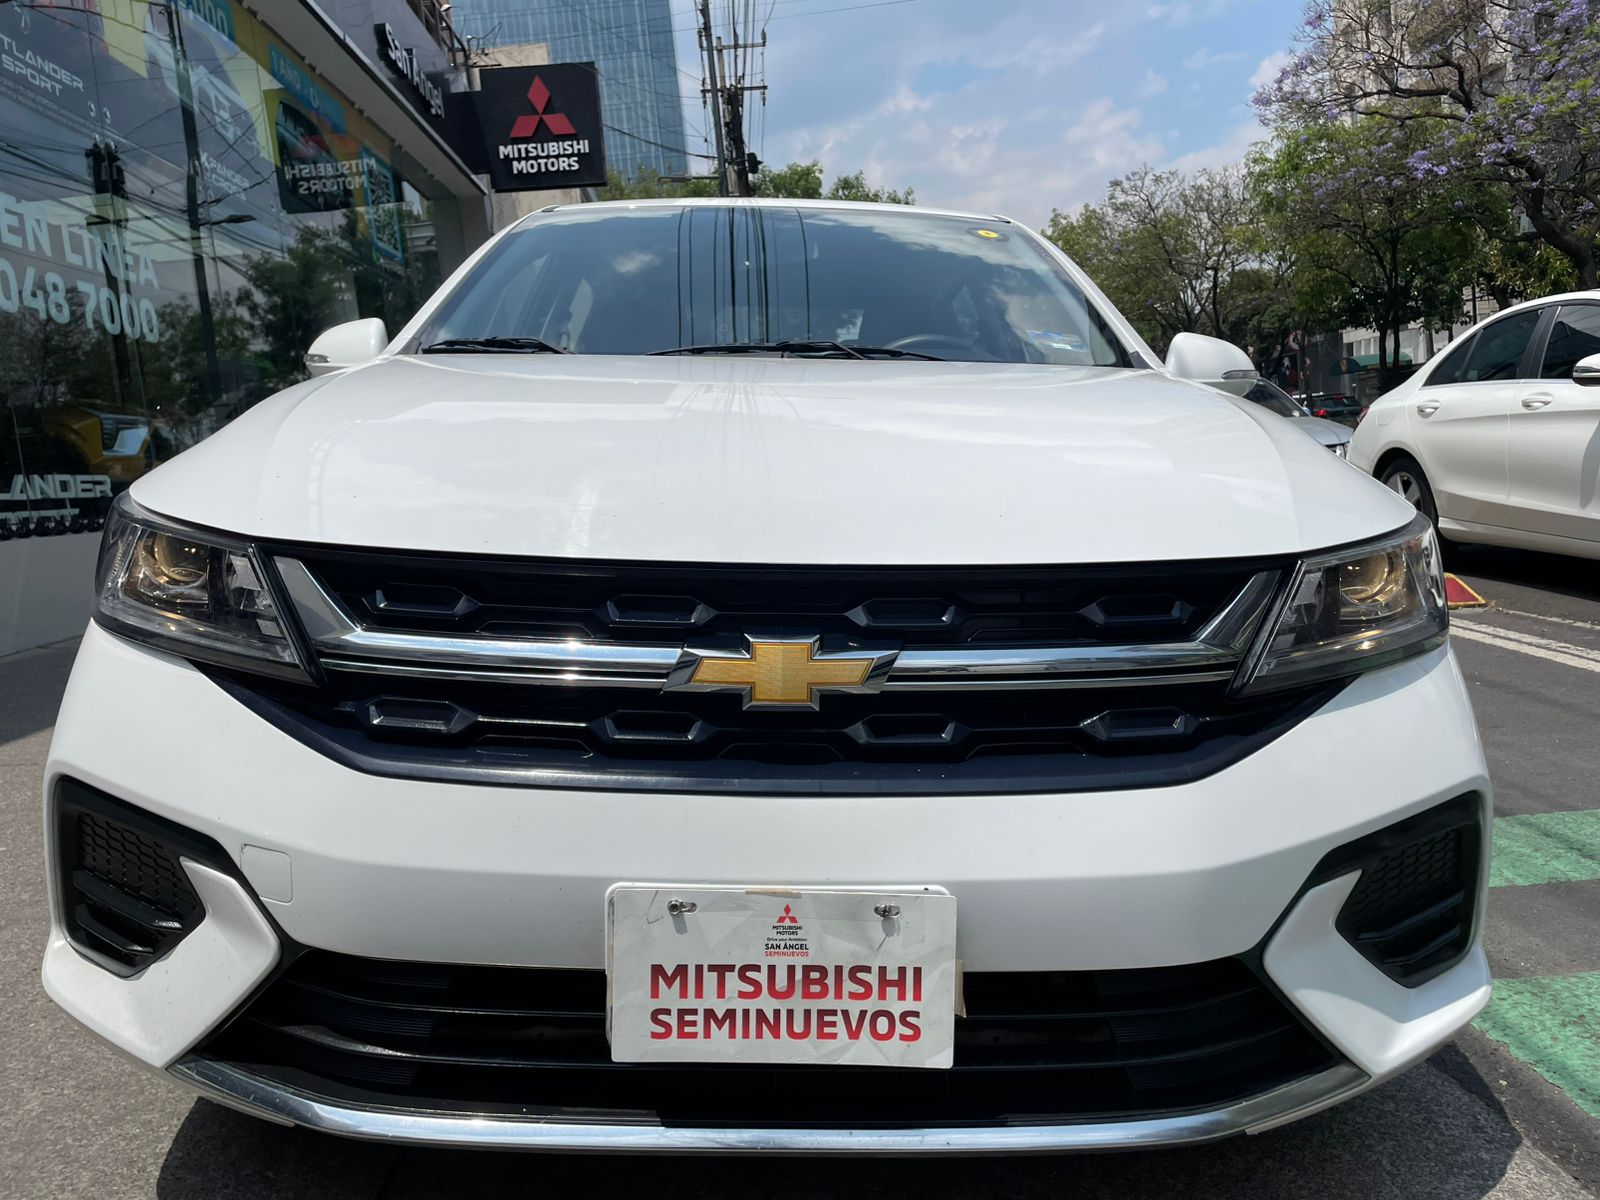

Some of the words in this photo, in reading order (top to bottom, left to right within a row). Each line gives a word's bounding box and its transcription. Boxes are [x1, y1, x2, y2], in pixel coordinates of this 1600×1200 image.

[0, 33, 84, 92] TLANDER
[385, 22, 412, 80] San
[1, 53, 62, 96] SPORT
[499, 140, 590, 159] MITSUBISHI
[512, 157, 579, 174] MOTORS
[0, 190, 52, 257] EN
[76, 279, 160, 343] 7000
[782, 941, 809, 950] ÁNGEL
[649, 963, 923, 1002] MITSUBISHI
[649, 1007, 922, 1042] SEMINUEVOS
